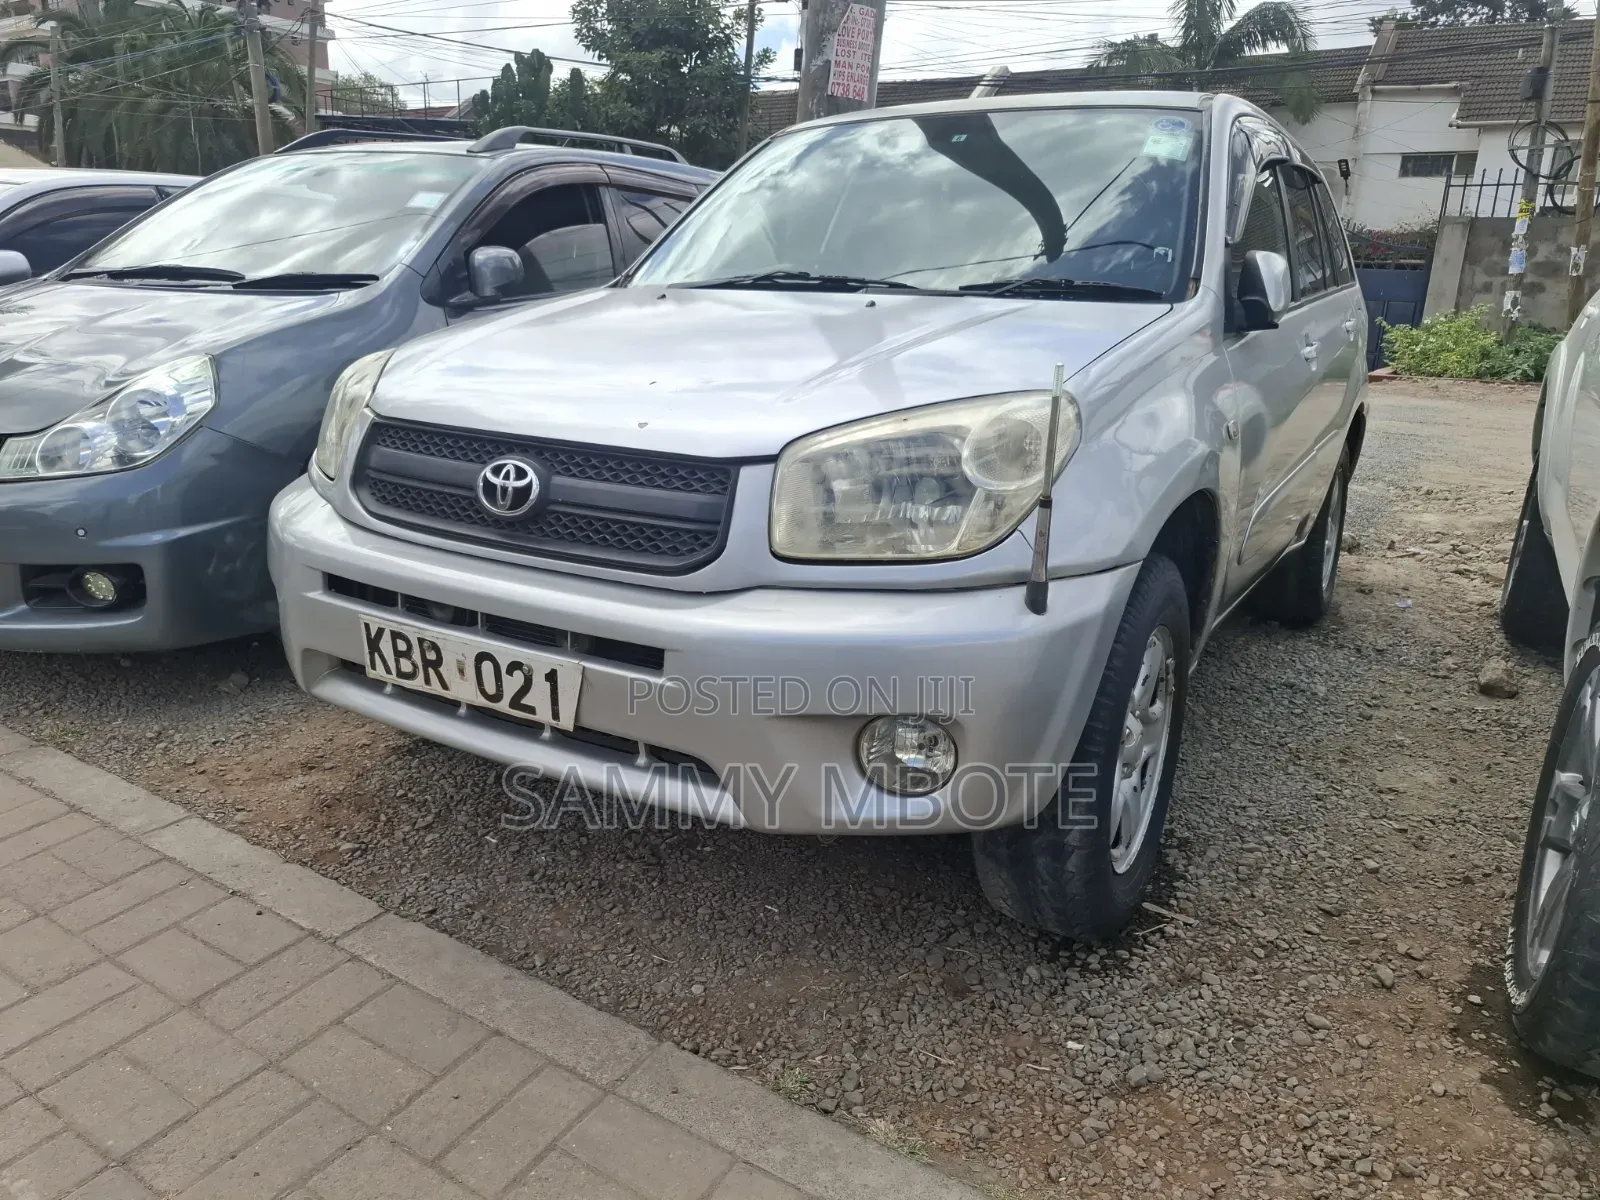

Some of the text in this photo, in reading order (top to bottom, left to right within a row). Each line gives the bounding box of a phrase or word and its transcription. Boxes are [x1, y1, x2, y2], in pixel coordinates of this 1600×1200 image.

[838, 26, 855, 38] LOVE
[837, 38, 857, 48] BUSINESS
[836, 48, 856, 59] LOST
[834, 60, 853, 70] MAN
[831, 82, 865, 100] 0738 648
[363, 622, 561, 723] KBR 021
